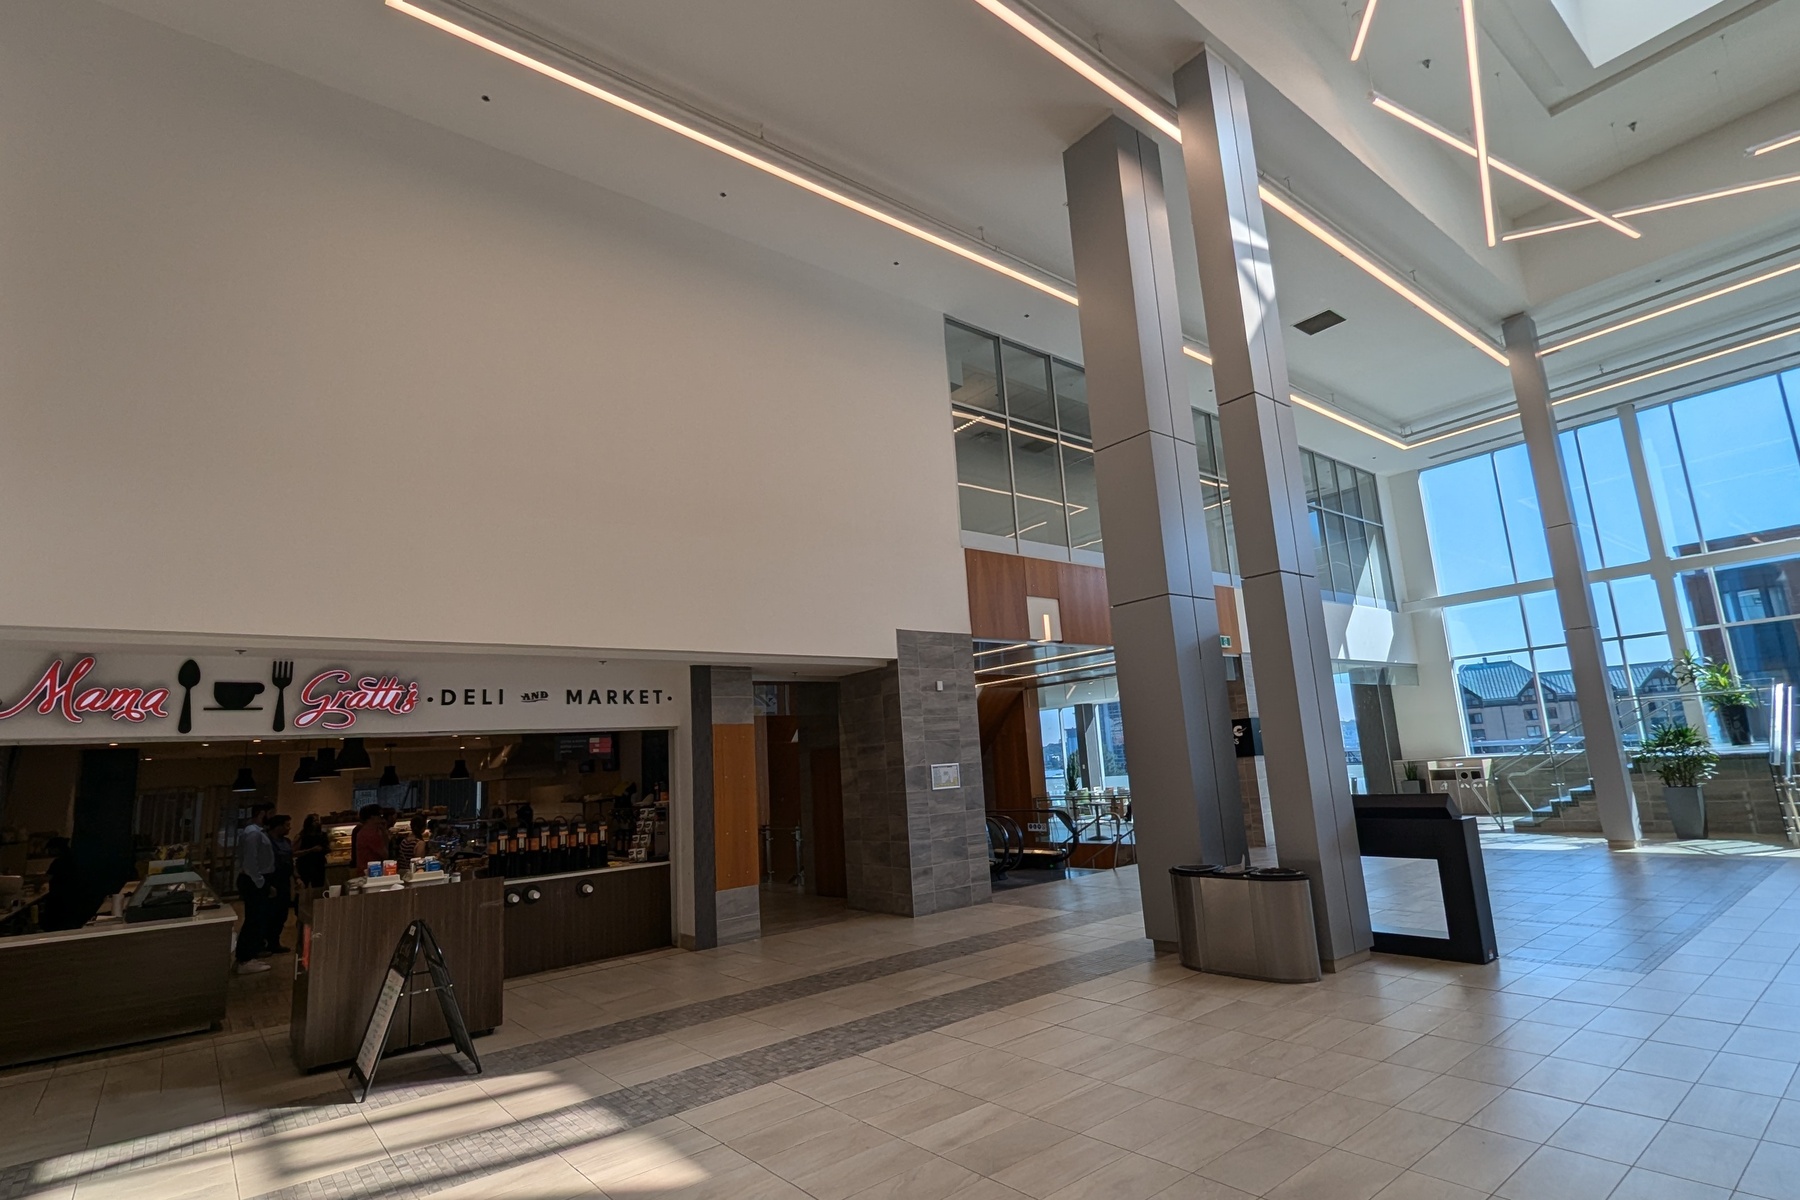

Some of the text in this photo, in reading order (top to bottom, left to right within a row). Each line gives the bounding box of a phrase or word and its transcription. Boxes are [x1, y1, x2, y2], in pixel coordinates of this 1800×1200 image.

[0, 656, 170, 723] Mama
[440, 688, 504, 705] DELI
[520, 690, 549, 701] AND
[566, 689, 663, 705] MARKET
